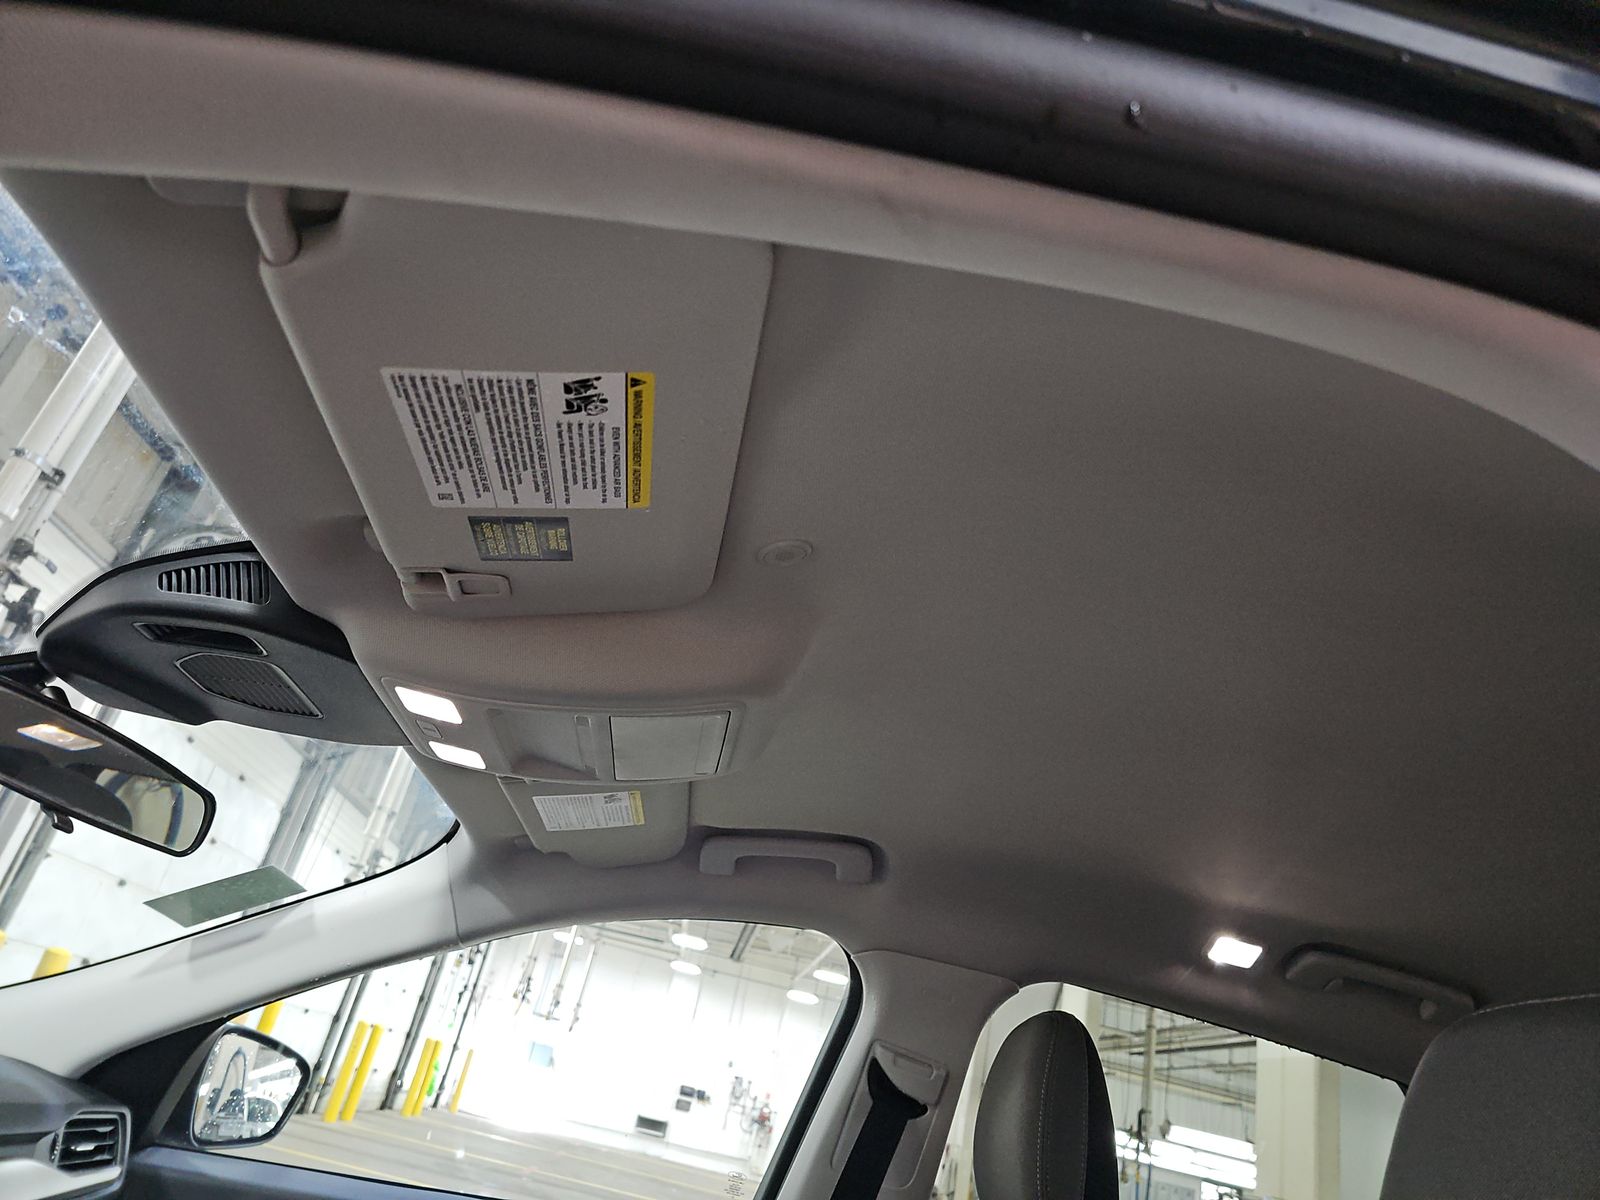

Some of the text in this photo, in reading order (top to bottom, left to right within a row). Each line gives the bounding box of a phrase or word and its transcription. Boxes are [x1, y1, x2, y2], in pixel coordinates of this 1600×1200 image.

[529, 396, 539, 411] AVEC
[633, 389, 643, 419] WARNING
[531, 412, 540, 422] DES
[465, 427, 476, 436] LAS
[534, 423, 542, 436] SACS
[611, 427, 620, 440] EVEN
[469, 437, 481, 456] NUEVAS
[535, 438, 547, 468] GONFLABLES
[474, 457, 486, 475] BOLSAS
[613, 454, 621, 477] ADVANCED
[482, 483, 491, 493] AIRE
